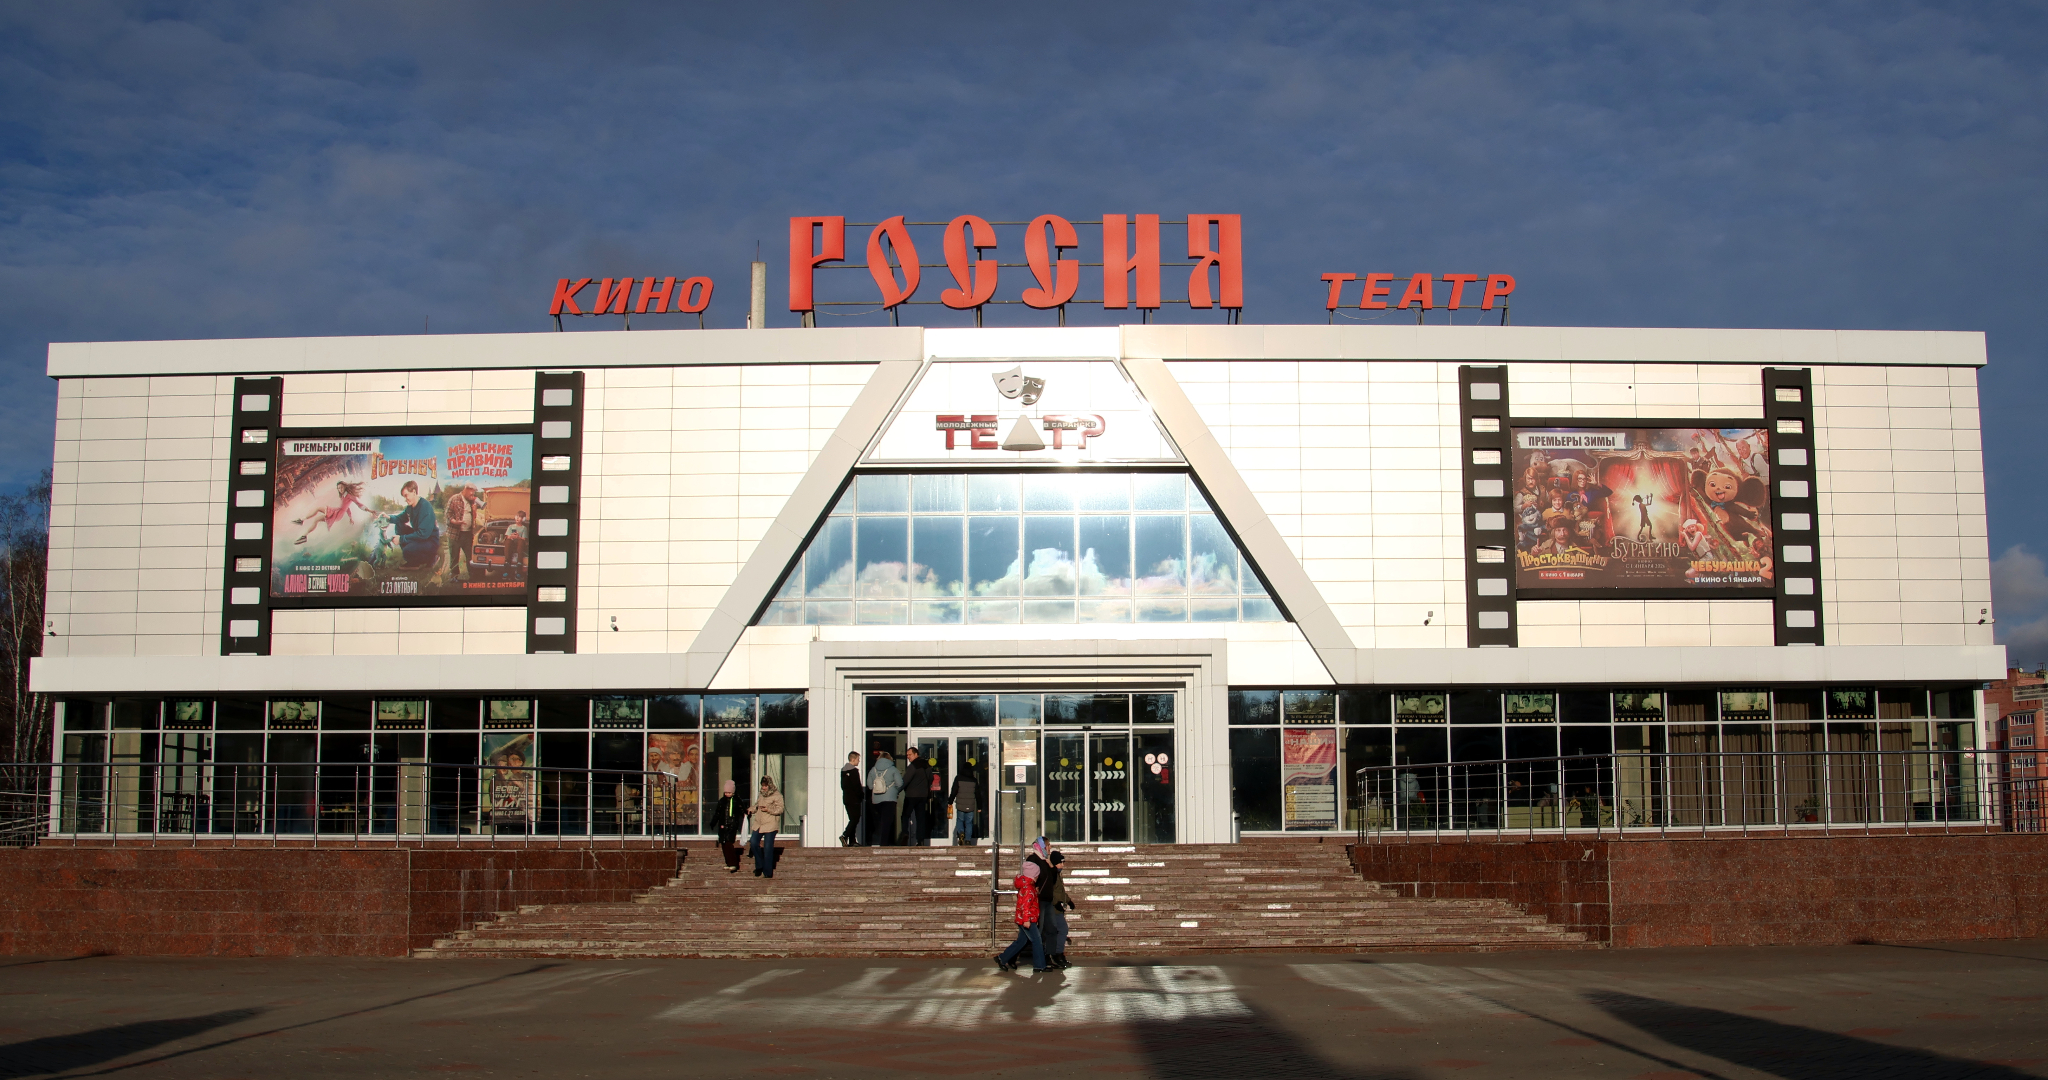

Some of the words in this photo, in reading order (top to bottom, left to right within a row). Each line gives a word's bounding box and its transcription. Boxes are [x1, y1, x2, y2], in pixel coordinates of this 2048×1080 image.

[789, 213, 1243, 311] РОССИЯ
[549, 276, 714, 315] КИНО
[1321, 272, 1516, 310] ТЕАТР
[293, 443, 342, 453] ПРЕМЬЕРЫ
[343, 441, 372, 452] ОСЕНИ
[448, 442, 514, 457] МУЖСКИЕ
[1528, 436, 1582, 447] ПРЕМЬЕРЫ
[1584, 435, 1616, 447] ЗИМЫ
[446, 453, 513, 470] ПРАВИЛА
[452, 468, 481, 479] МОЕГО
[482, 467, 509, 478] ДЕДА
[1516, 547, 1608, 567] ПРОСТОКВАШИНО
[1690, 560, 1760, 572] ЧЕБУРАШКА
[1759, 556, 1773, 580] 2
[284, 574, 307, 593] АЛИСА
[327, 573, 350, 593] ЧУДЕС
[381, 582, 385, 594] С
[386, 582, 393, 594] 23
[394, 581, 418, 594] ОКТЯБРЯ
